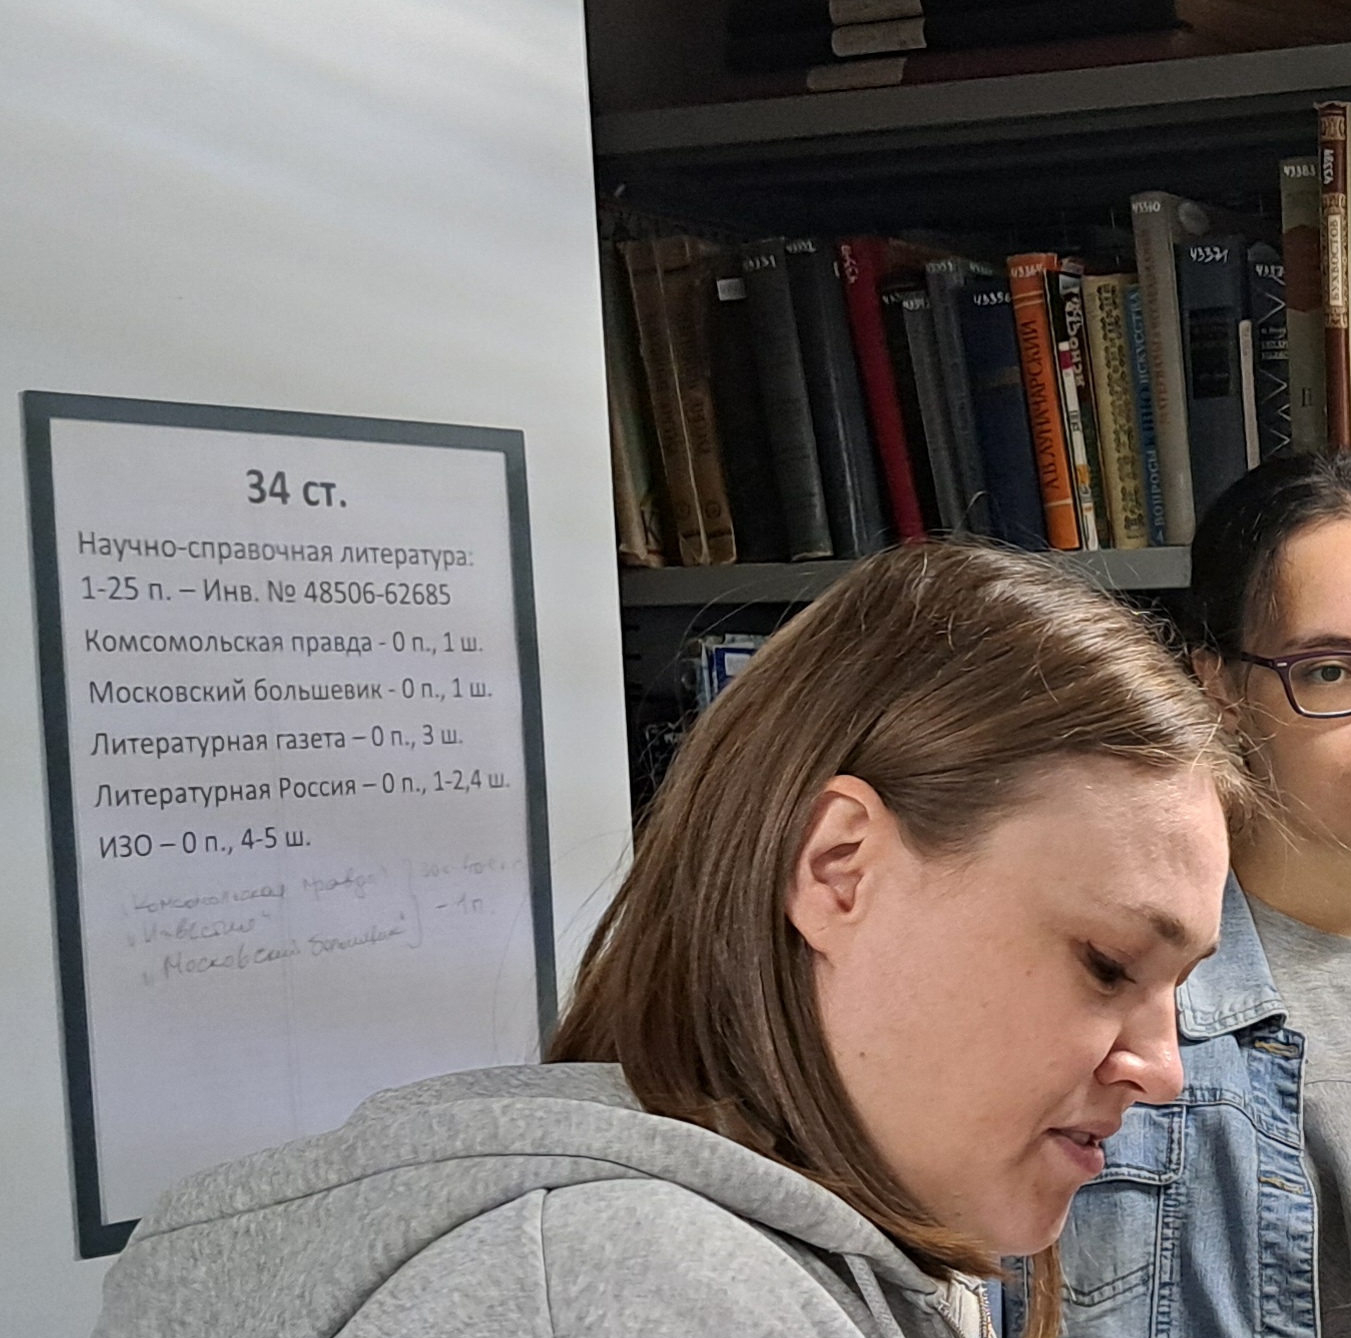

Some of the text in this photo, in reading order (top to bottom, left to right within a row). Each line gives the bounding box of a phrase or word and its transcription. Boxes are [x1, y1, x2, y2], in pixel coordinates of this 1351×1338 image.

[1330, 218, 1340, 304] БУХВОСТОВ
[1128, 289, 1149, 385] ИСКУССТВА
[246, 469, 347, 508] 34 ст.
[1146, 449, 1165, 527] ВОПРОСЫ
[78, 531, 474, 571] Научно-справочная литература:
[81, 575, 139, 602] 1-25
[148, 583, 172, 602] п.
[203, 578, 259, 603] Инв.
[268, 579, 296, 603] №
[304, 581, 451, 606] 48506-62685
[85, 629, 283, 653] Комсомольская
[291, 635, 372, 658] правда
[392, 631, 405, 653] 0
[412, 636, 437, 657] п.,
[443, 631, 455, 653] 1
[461, 636, 483, 654] ш.
[89, 678, 246, 704] Московский
[254, 678, 382, 702] большевик
[402, 677, 415, 700] 0
[421, 681, 446, 704] п.,
[452, 678, 463, 700] 1
[470, 682, 493, 700] ш.
[91, 732, 268, 759] Литературная
[276, 731, 346, 752] газета
[371, 726, 384, 748] 0
[391, 729, 415, 751] п.,
[422, 725, 435, 747] 3
[441, 729, 463, 747] ш.
[94, 782, 271, 810] Литературная
[279, 777, 356, 800] Россия
[382, 773, 395, 794] 0
[401, 775, 427, 797] п.,
[433, 769, 482, 794] 1-2,4
[488, 771, 510, 789] ш.
[99, 833, 152, 858] ИЗО
[182, 831, 197, 854] 0
[204, 835, 233, 856] п.,
[241, 827, 277, 851] 4-5
[285, 828, 311, 850] ш.
